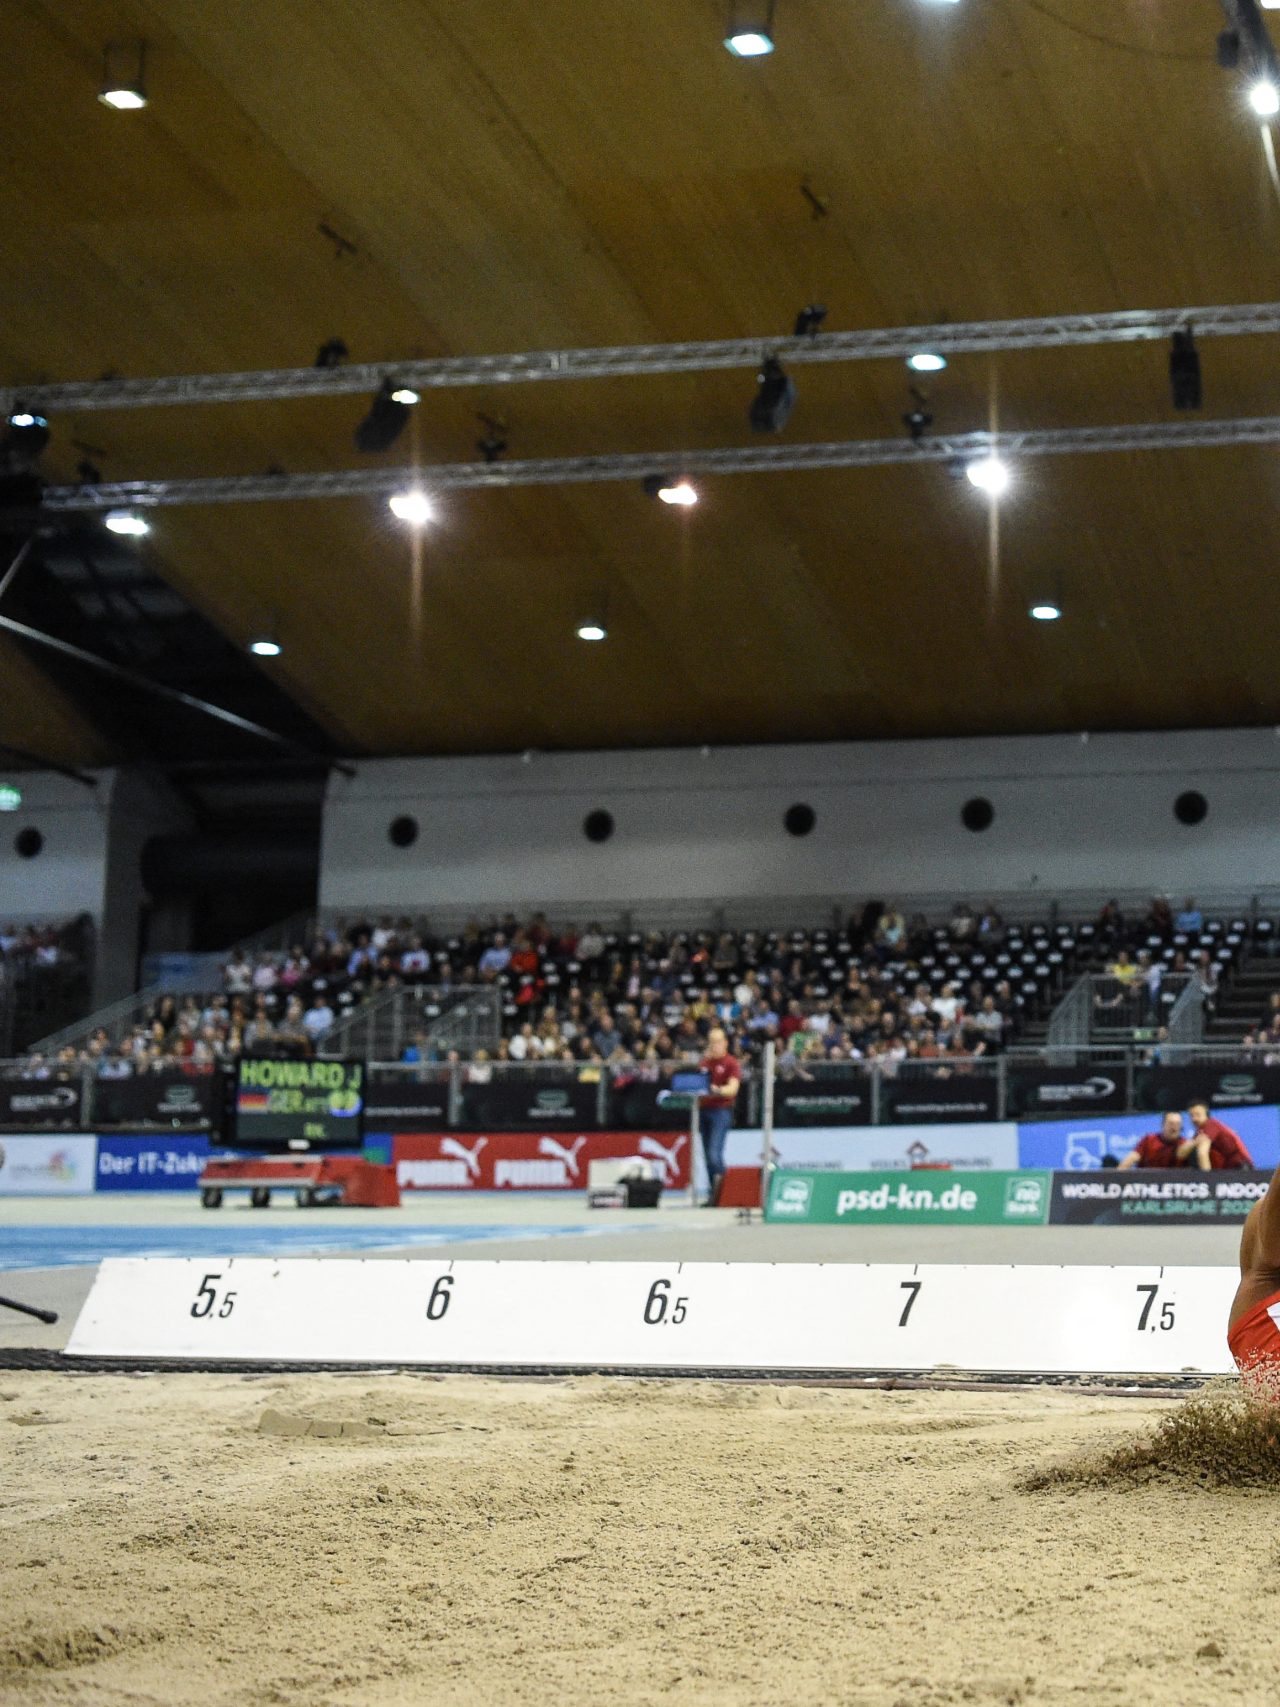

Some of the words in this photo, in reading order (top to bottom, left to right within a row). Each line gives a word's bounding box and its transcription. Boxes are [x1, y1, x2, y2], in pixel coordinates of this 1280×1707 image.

[241, 1060, 345, 1088] HOWARD
[100, 1152, 133, 1175] Der
[836, 1183, 978, 1217] psd-kn.de
[1061, 1183, 1121, 1199] WORLD
[1122, 1183, 1209, 1200] ATHLETICS
[425, 1275, 455, 1321] 6
[898, 1281, 923, 1328] 7
[1136, 1284, 1175, 1333] 7,5
